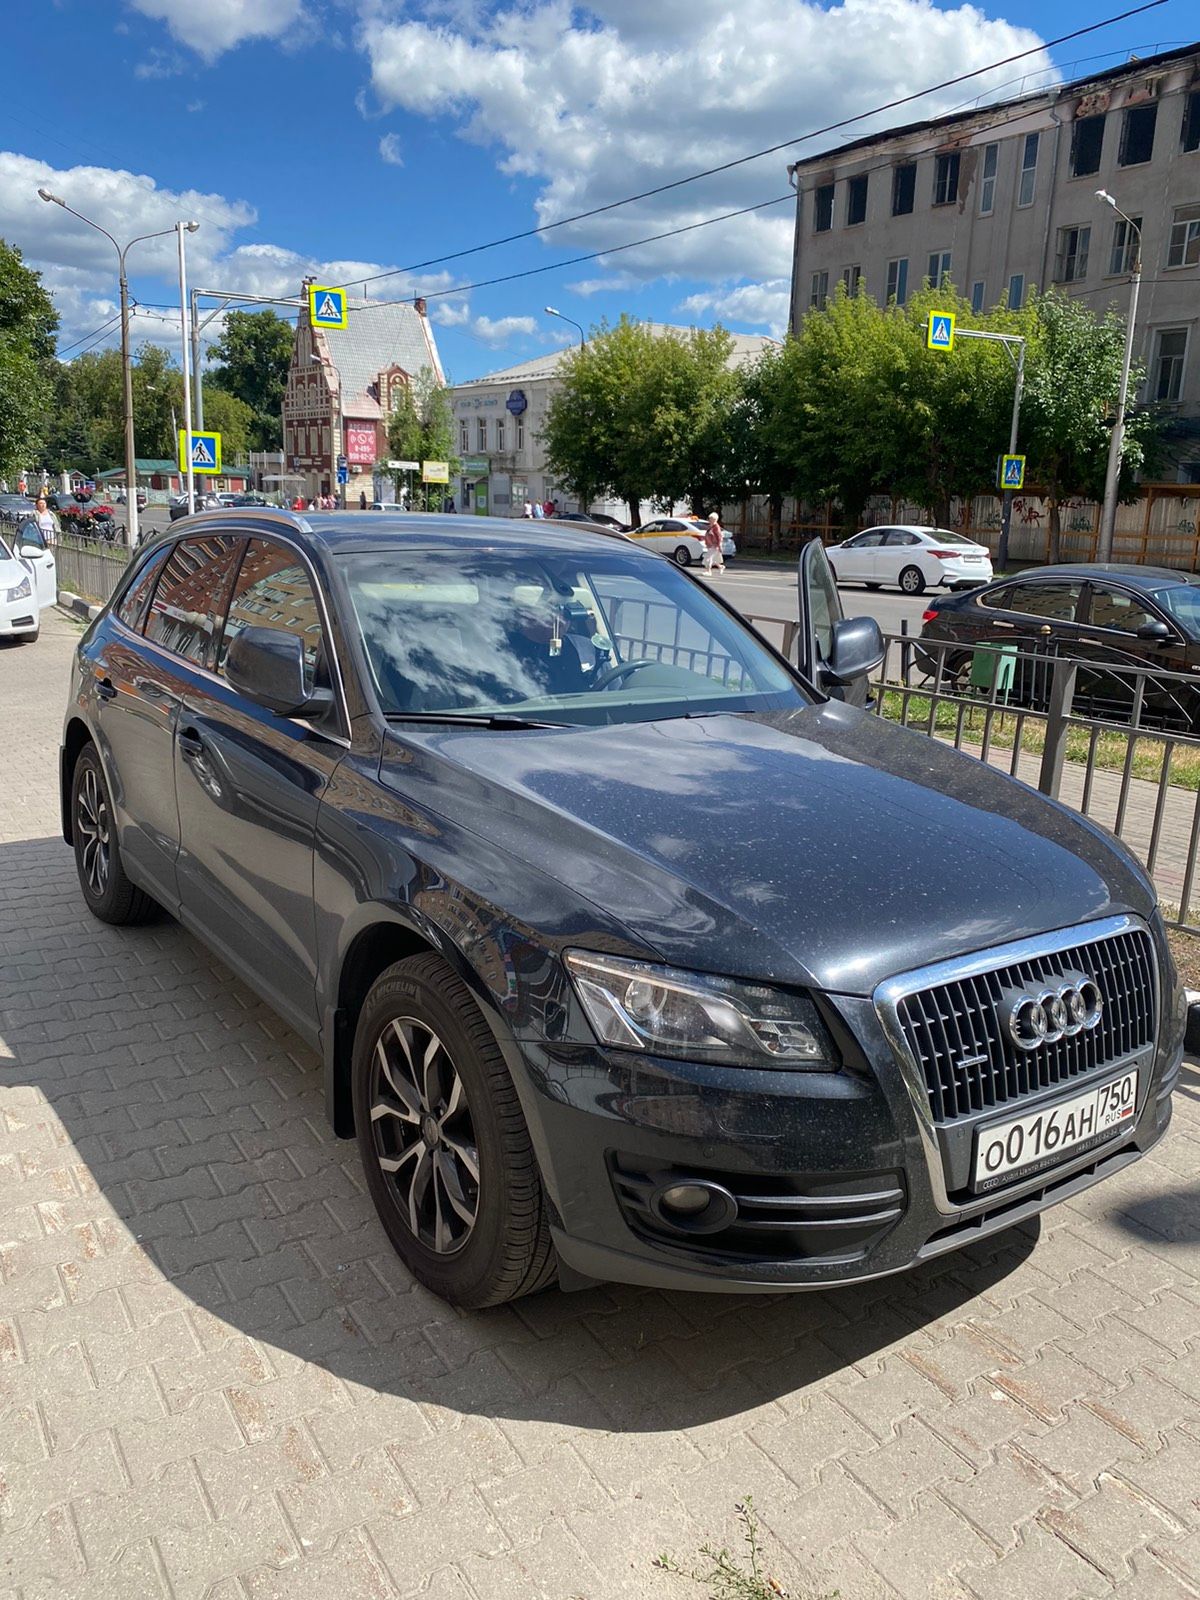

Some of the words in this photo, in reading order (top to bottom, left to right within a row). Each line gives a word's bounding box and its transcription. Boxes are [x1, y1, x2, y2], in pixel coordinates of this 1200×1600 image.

[985, 1103, 1095, 1172] О016АН
[1099, 1076, 1132, 1117] 750
[1104, 1108, 1122, 1126] RUS
